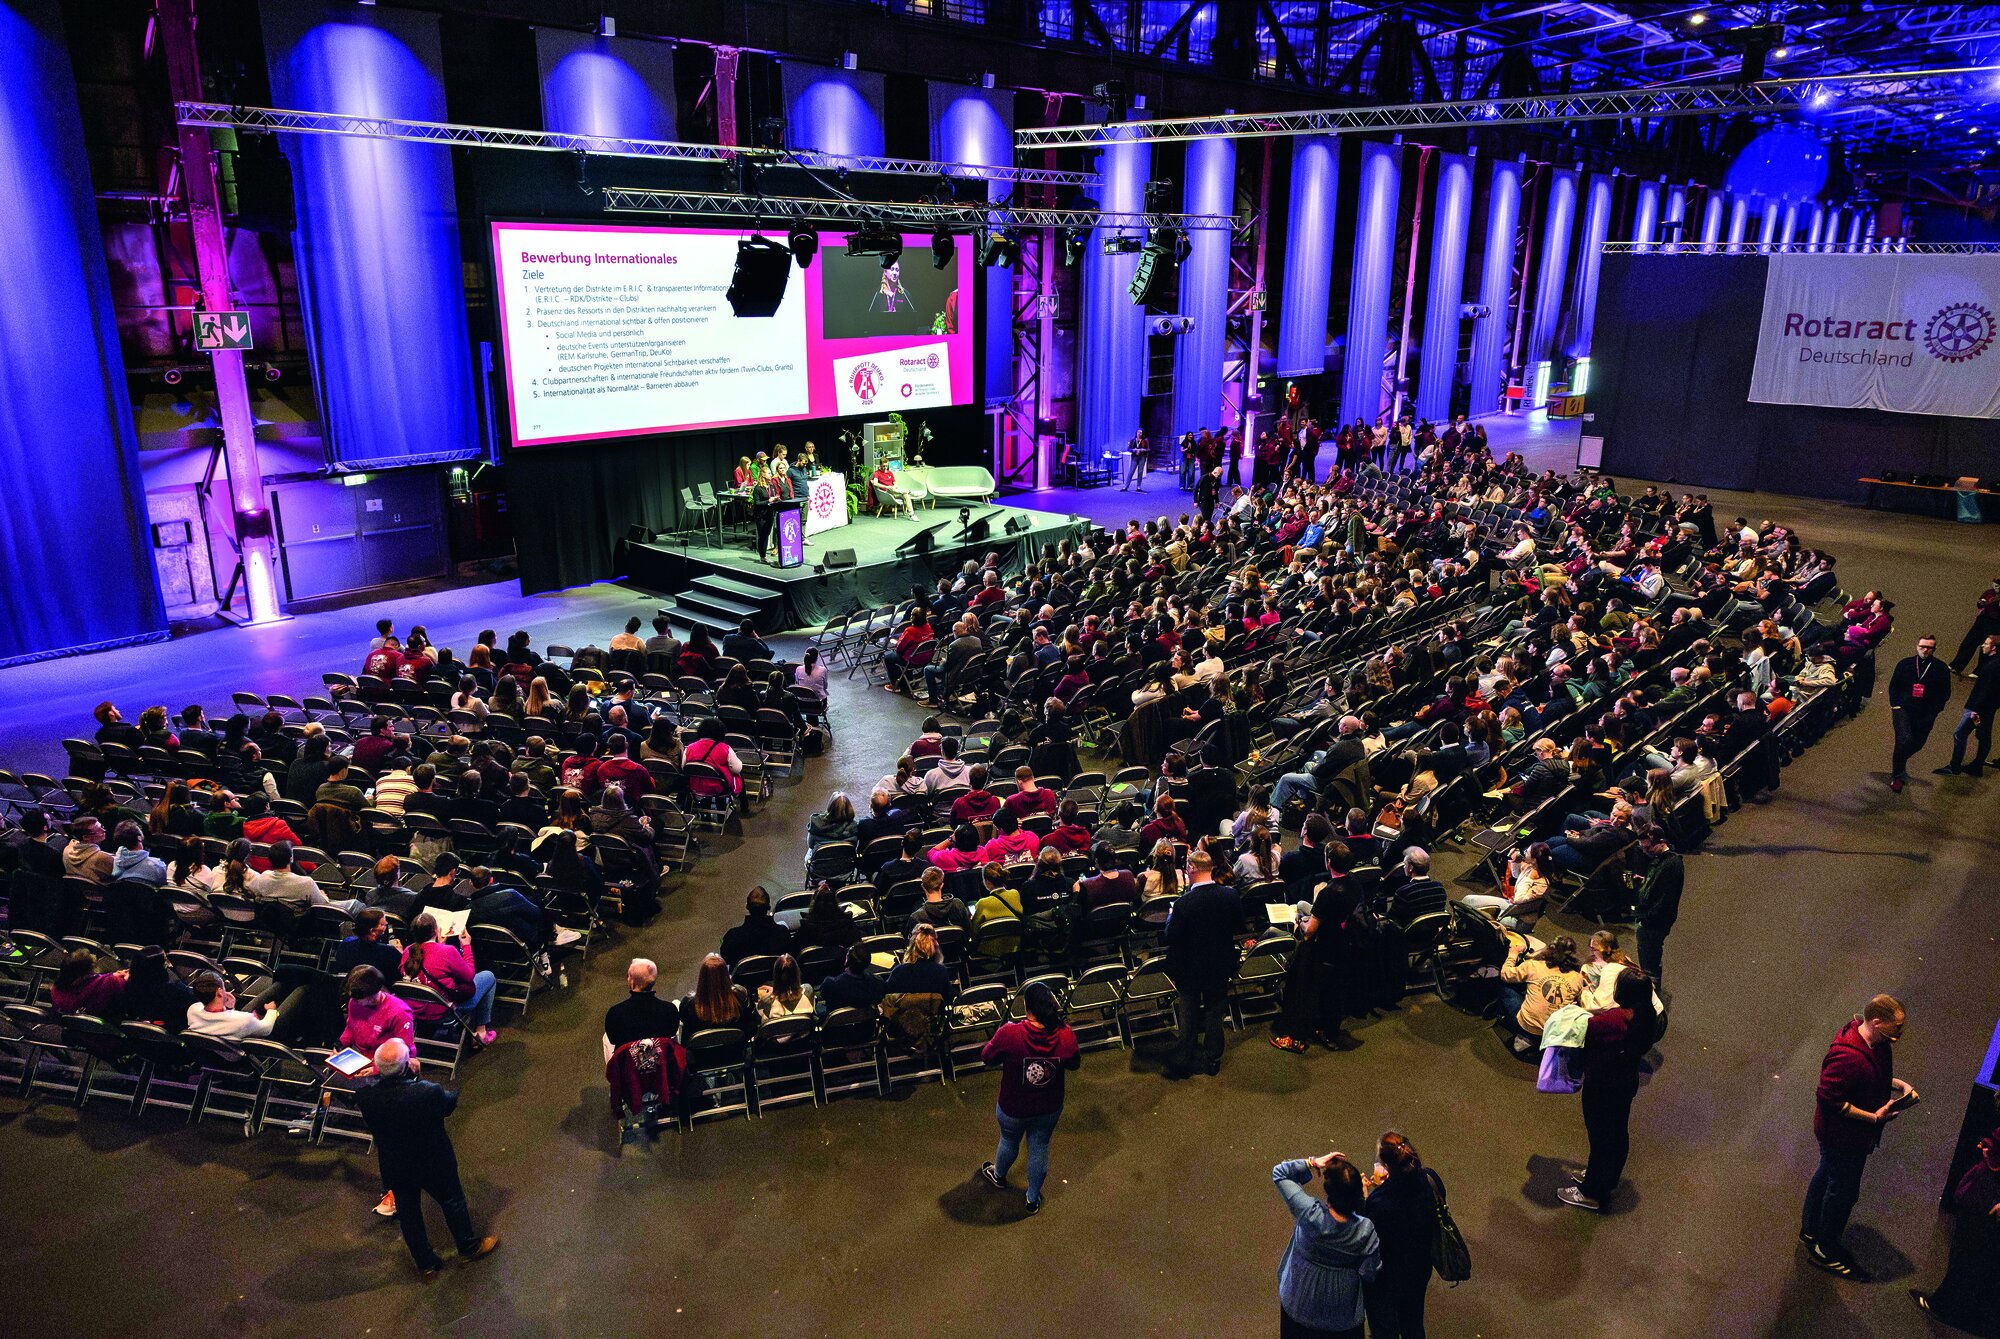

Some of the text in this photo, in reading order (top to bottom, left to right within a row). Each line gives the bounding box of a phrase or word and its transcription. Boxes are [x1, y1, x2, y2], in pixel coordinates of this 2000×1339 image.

[521, 251, 678, 267] Bewerbung Internationales
[522, 269, 545, 280] Ziele
[534, 285, 572, 295] Vertretung
[573, 285, 585, 293] der
[585, 284, 613, 293] Distrikte
[613, 285, 622, 293] im
[646, 284, 652, 293] &
[653, 285, 693, 294] transparenter
[693, 284, 730, 292] Informations
[570, 294, 613, 303] RDK/Distrikte
[619, 294, 640, 303] Clubs)
[525, 307, 533, 316] 2.
[536, 307, 563, 316] Präsenz
[563, 307, 576, 315] des
[577, 306, 604, 315] Ressorts
[612, 306, 625, 314] den
[626, 305, 656, 314] Distrikten
[656, 305, 688, 314] nachhaltig
[688, 304, 717, 312] verankern
[527, 316, 709, 329] 3. Deutschland international sichtbar & offen positionieren
[1783, 312, 1918, 342] Rotaract
[555, 328, 645, 340] Social Media und persönlich
[556, 342, 587, 351] deutsche
[588, 341, 609, 350] Events
[557, 348, 672, 362] (REM Karlsruhe, GermanTrip, DeuKo)
[1799, 347, 1914, 368] Deutschland
[558, 356, 731, 373] deutschen Projekten international Sichtbarkeit verschaffen
[899, 358, 926, 366] Rotaract
[531, 378, 539, 387] 4.
[542, 374, 609, 386] Clubpartnerschaften
[610, 373, 616, 382] &
[616, 371, 659, 381] internationale
[659, 369, 704, 378] Freundschaften
[704, 368, 719, 376] aktiv
[719, 366, 740, 375] fördern
[774, 363, 794, 372] Grants)
[849, 361, 870, 384] RUHRPOTT
[532, 390, 541, 399] 5.
[543, 387, 596, 398] Internationalität
[596, 386, 606, 394] als
[606, 384, 640, 393] Normalität
[645, 382, 673, 391] Barrieren
[673, 381, 700, 389] abbauen
